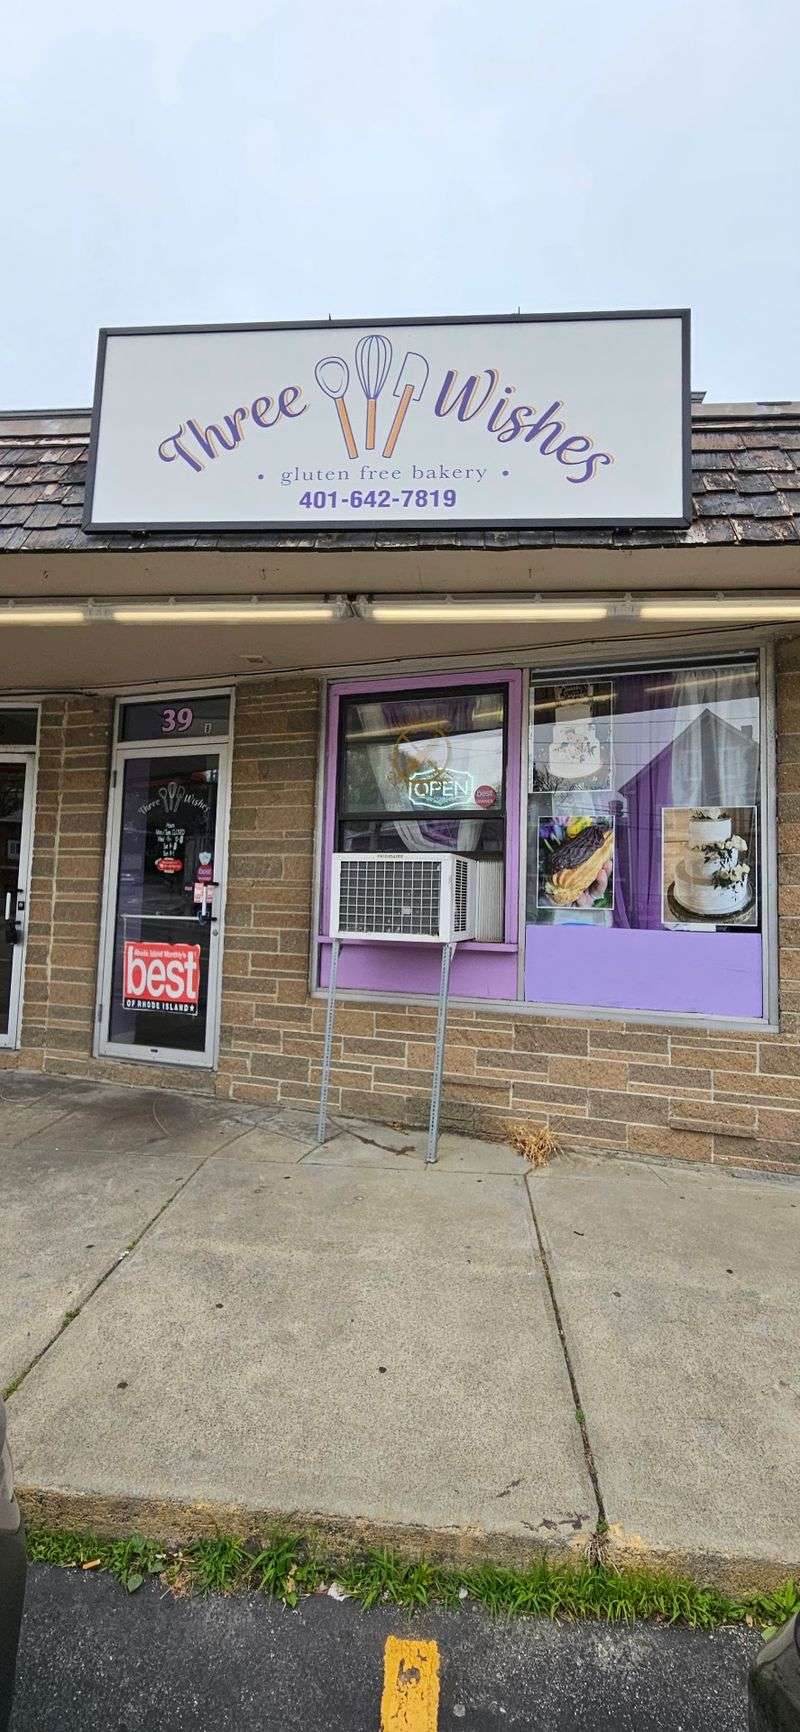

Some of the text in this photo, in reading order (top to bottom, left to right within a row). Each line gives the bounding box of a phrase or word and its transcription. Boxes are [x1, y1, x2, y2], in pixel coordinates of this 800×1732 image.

[158, 368, 614, 485] Three Wishes
[280, 464, 488, 487] gluten free bakery
[299, 488, 457, 510] 401-642-7819
[162, 707, 193, 731] 39
[414, 781, 468, 797] OPEN
[127, 945, 197, 999] best
[126, 1000, 189, 1012] OF RHODE ISLAND
